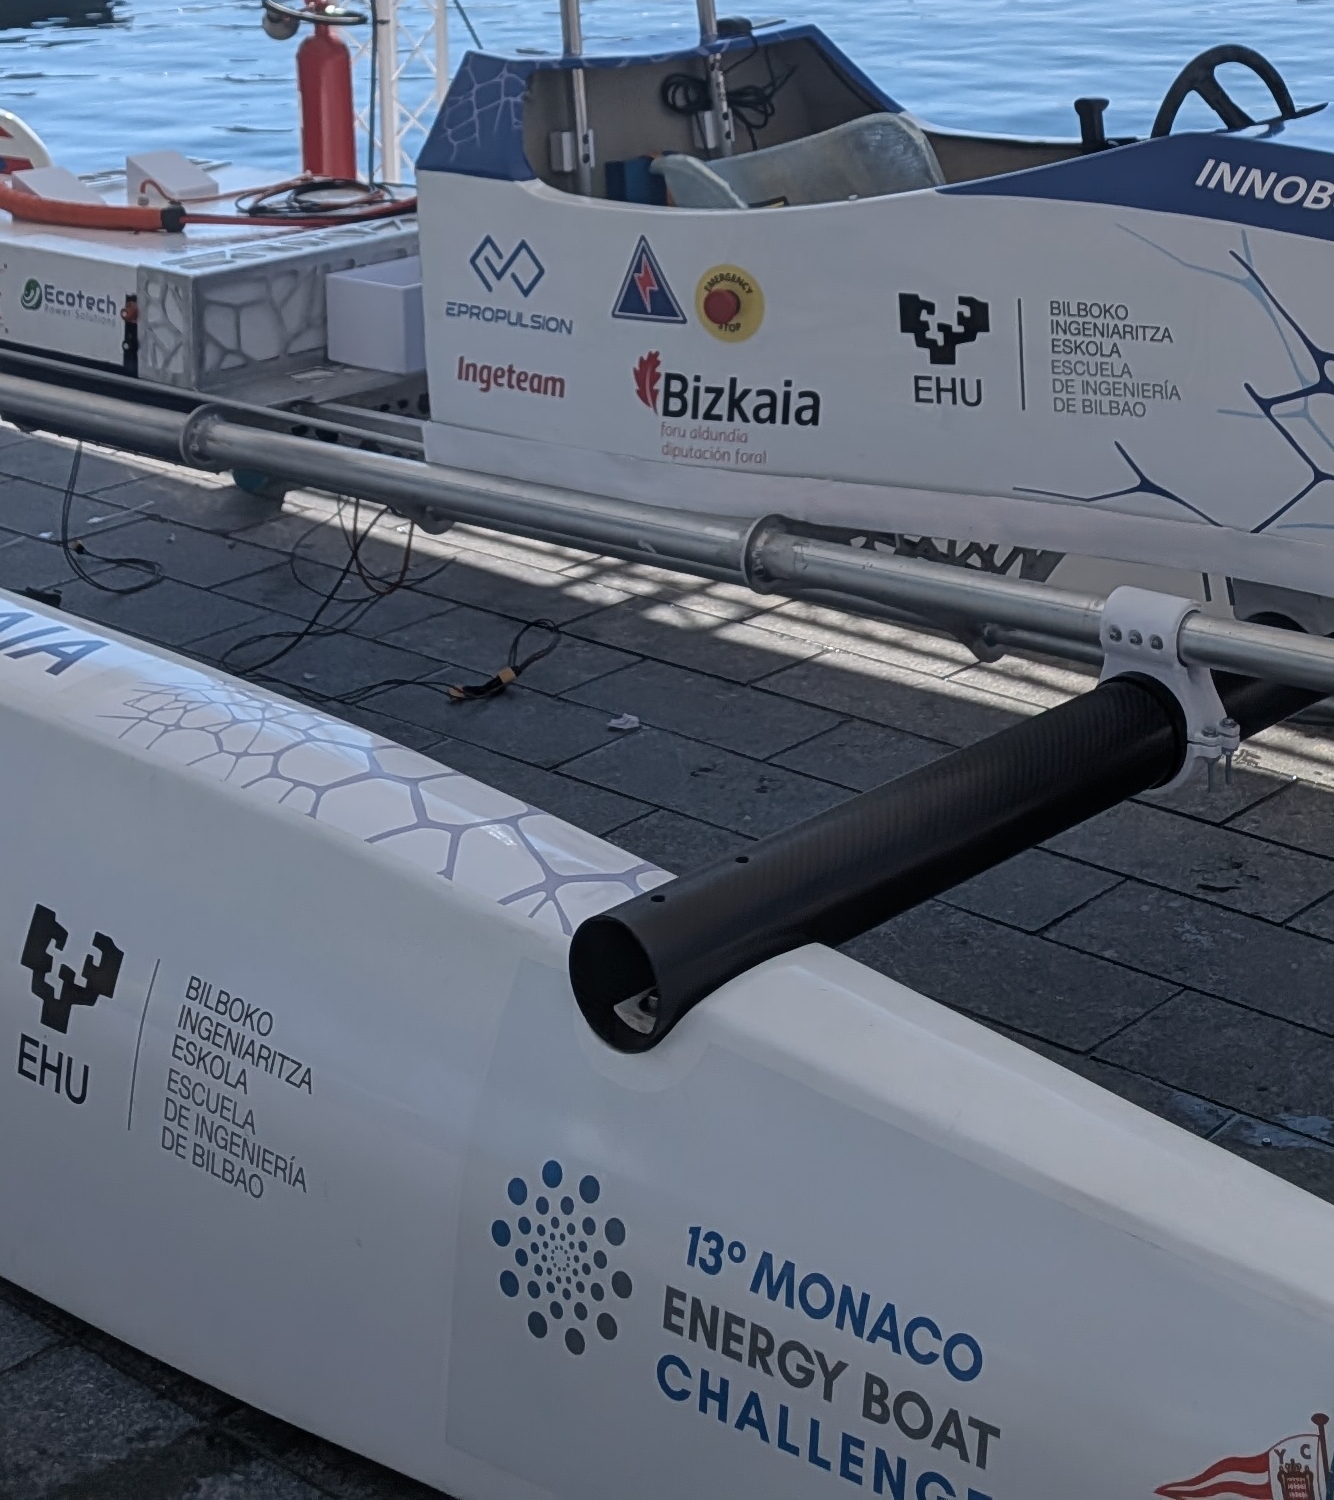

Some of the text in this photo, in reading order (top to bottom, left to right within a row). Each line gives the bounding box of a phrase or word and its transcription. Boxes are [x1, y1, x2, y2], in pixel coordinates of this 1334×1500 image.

[44, 283, 117, 316] Ecotech
[445, 301, 574, 335] EPROPULSION
[1049, 300, 1129, 321] BILBOKO
[1050, 319, 1174, 344] INGENIARITZA
[1050, 338, 1122, 359] ESKOLA
[457, 355, 566, 399] Ingeteam
[1050, 359, 1133, 379] ESCUELA
[661, 371, 821, 426] Bizkaia
[913, 374, 983, 407] EHU
[1052, 378, 1182, 401] DE INGENIERÍA
[1053, 397, 1147, 418] DE BILBAO
[660, 421, 749, 444] foru aldundia
[661, 442, 767, 465] diputación foral
[185, 975, 274, 1037] BILBOKO
[17, 1032, 90, 1105] EHU
[171, 1034, 248, 1095] ESKOLA
[177, 1004, 313, 1094] INGENIARITZA
[167, 1068, 256, 1135] ESCUELA
[161, 1125, 264, 1199] DE BILBAO
[163, 1097, 307, 1193] DE INGENIERÍA
[749, 1250, 983, 1382] MONACO
[662, 1284, 1001, 1470] ENERGY BOAT
[656, 1354, 994, 1500] CHALLENG
[1273, 1443, 1312, 1465] Y C
